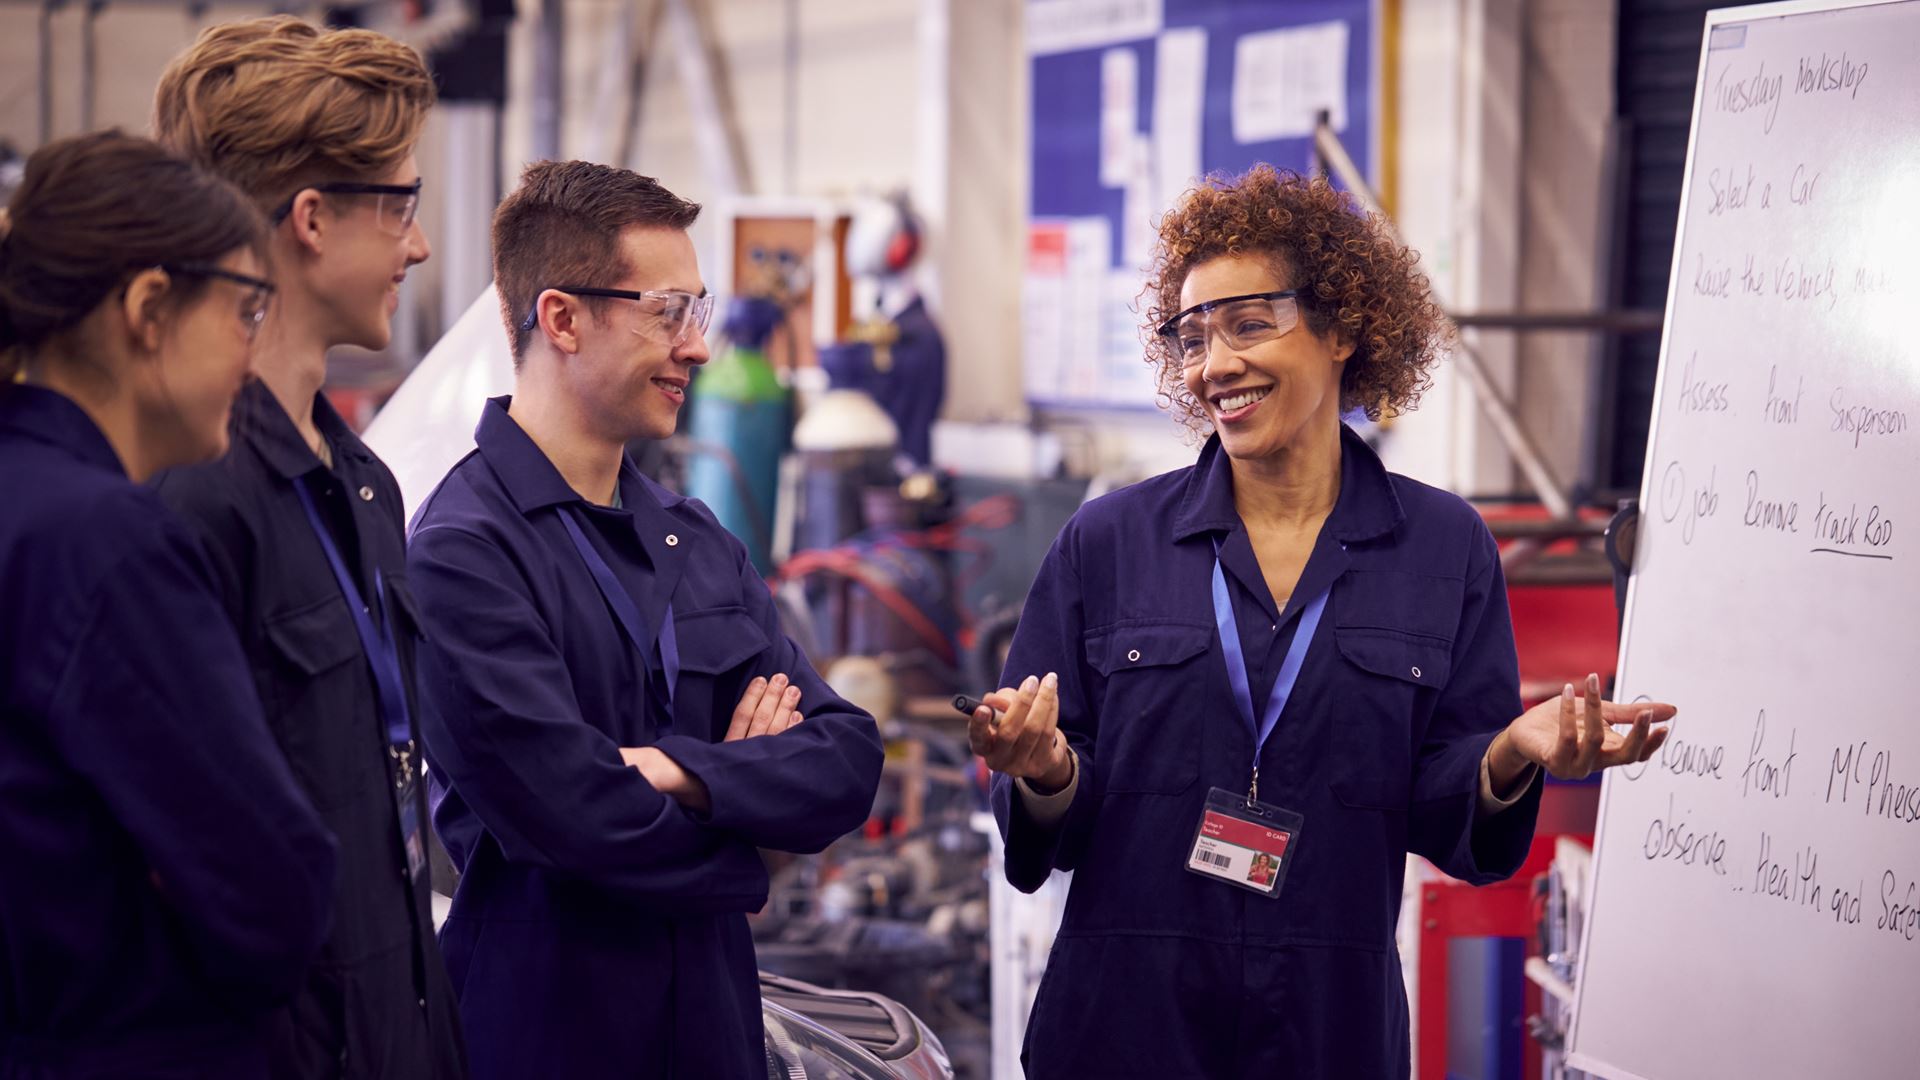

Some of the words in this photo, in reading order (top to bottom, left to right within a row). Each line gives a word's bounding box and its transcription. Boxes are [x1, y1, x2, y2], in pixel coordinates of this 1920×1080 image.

[1714, 61, 1783, 135] Tuesday
[1795, 52, 1868, 100] Workshop
[1708, 164, 1755, 215] Select
[1761, 183, 1771, 209] a
[1790, 163, 1821, 206] Car
[1693, 252, 1731, 298] Raise
[1741, 253, 1765, 297] the
[1830, 386, 1907, 449] Suspension
[1744, 469, 1798, 533] Remove
[1272, 834, 1287, 842] CARD
[1751, 831, 1820, 913] Health
[1831, 879, 1863, 924] and
